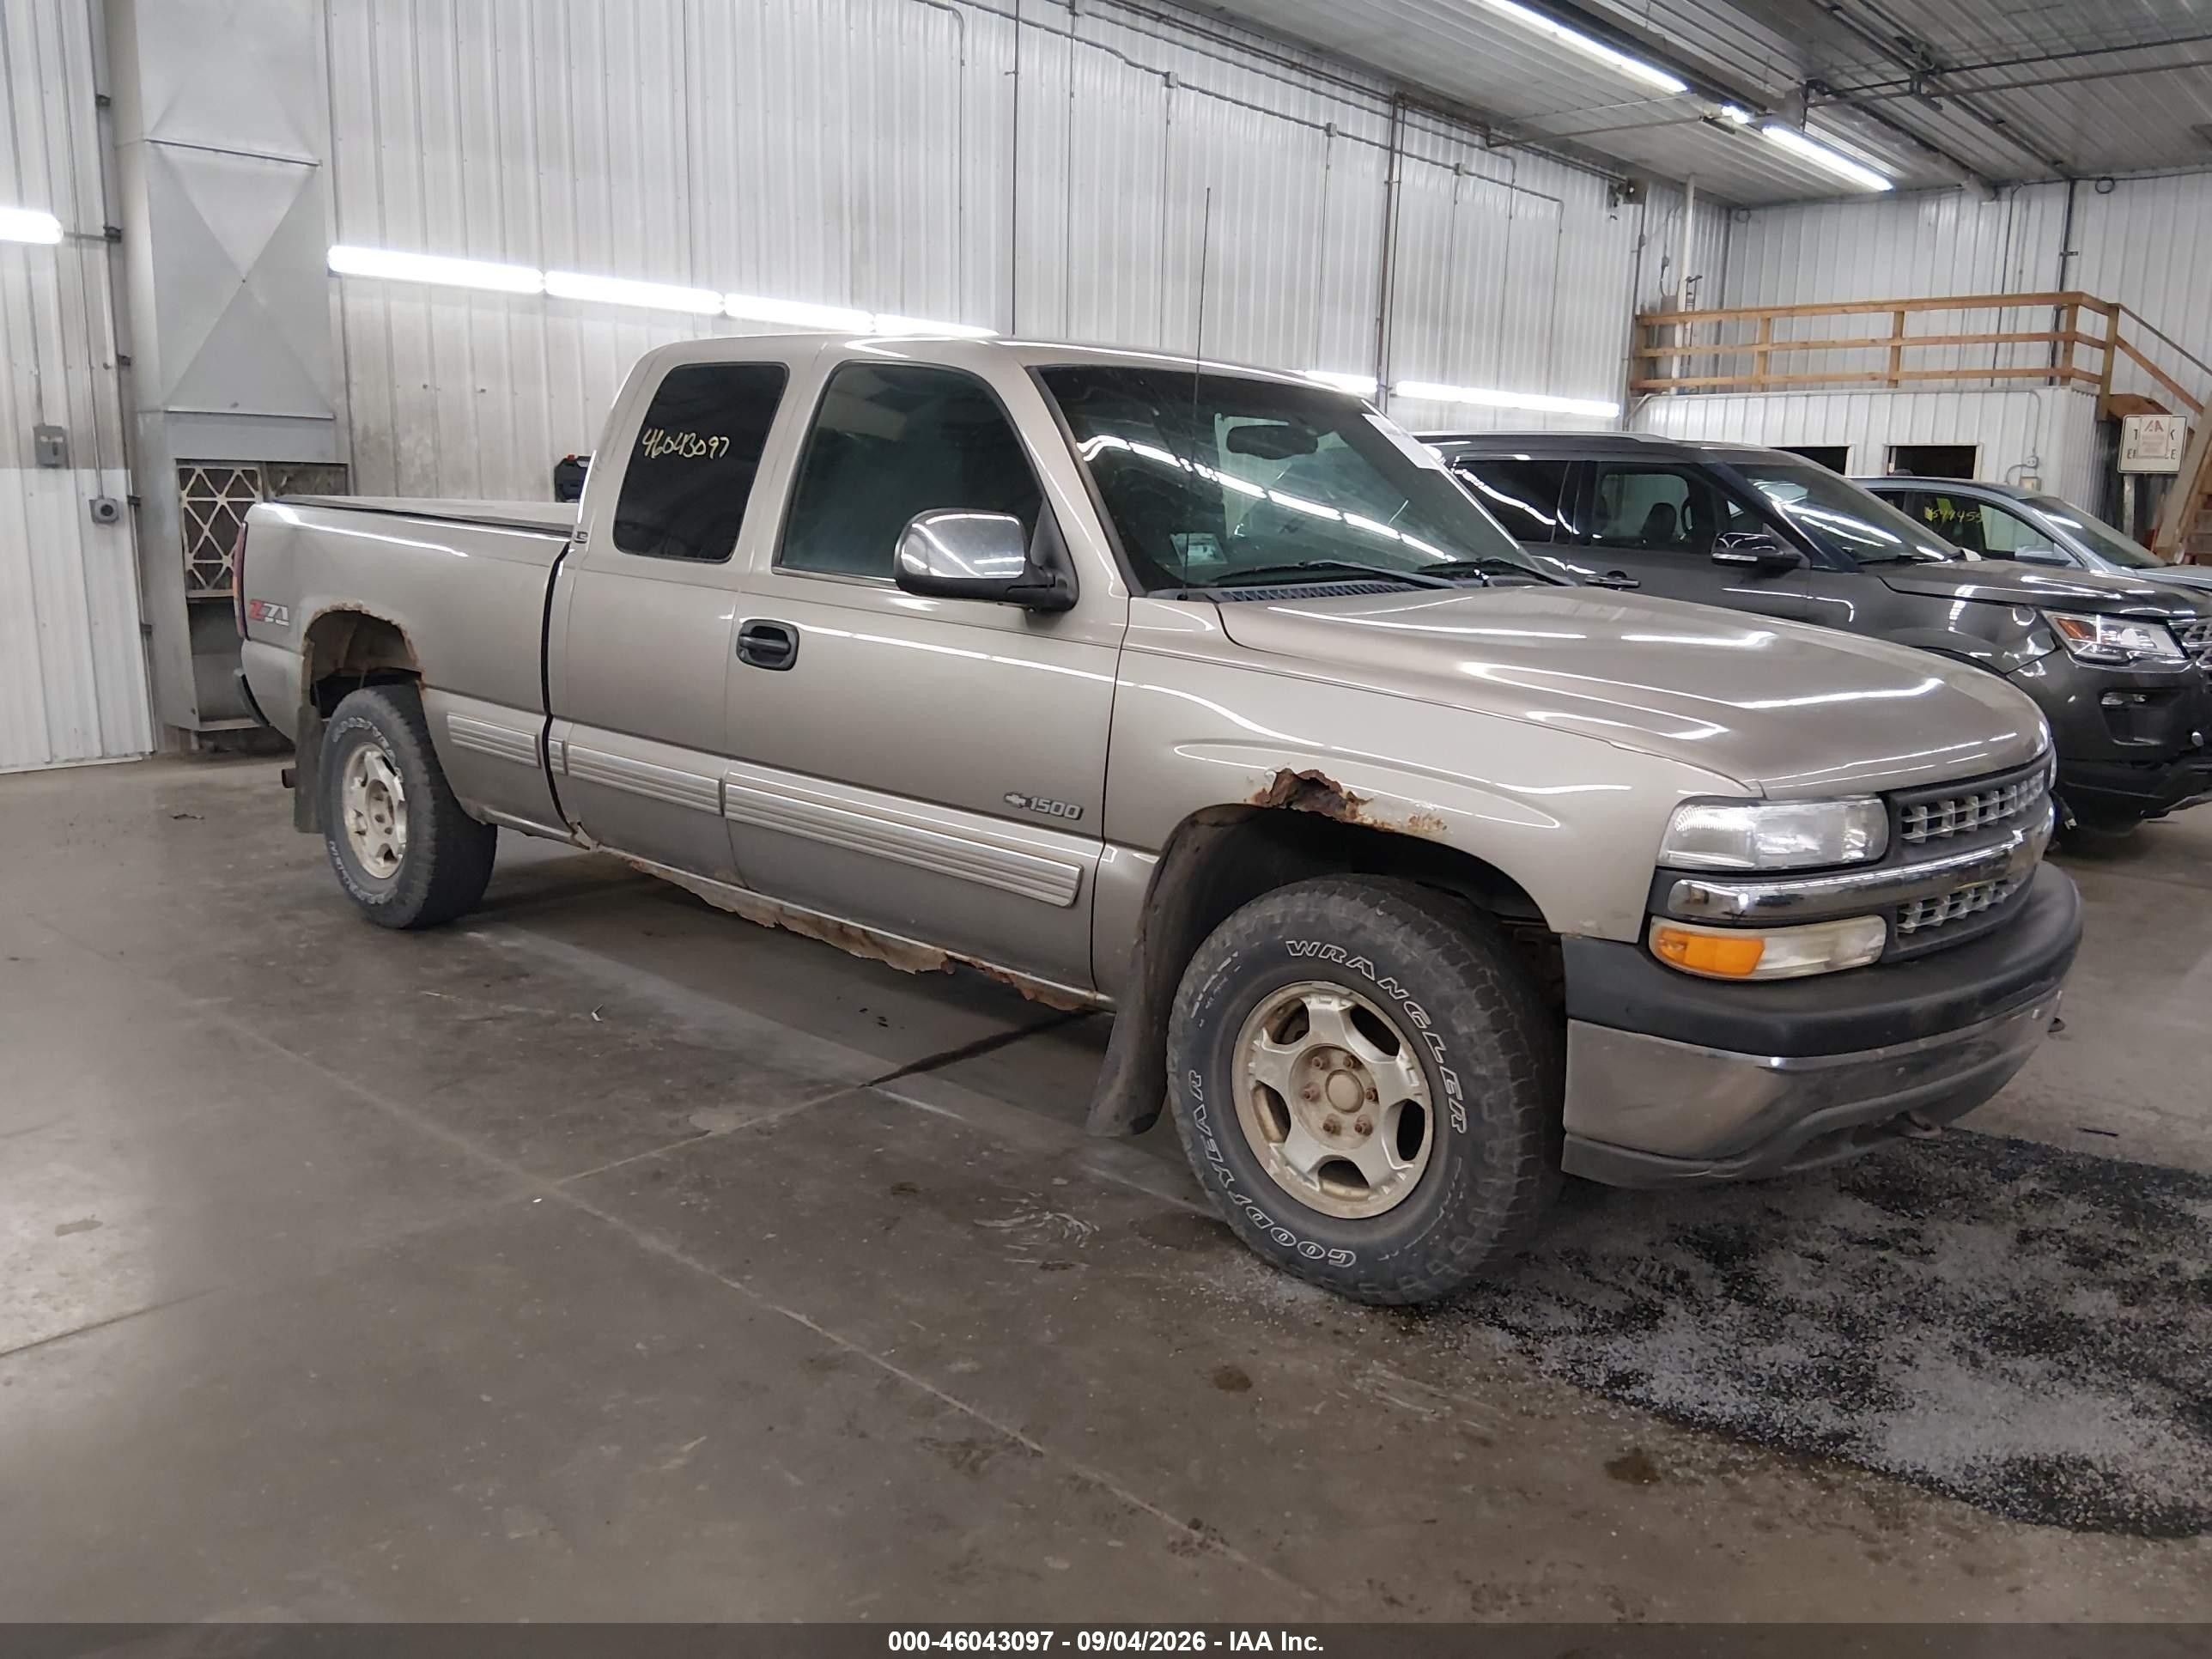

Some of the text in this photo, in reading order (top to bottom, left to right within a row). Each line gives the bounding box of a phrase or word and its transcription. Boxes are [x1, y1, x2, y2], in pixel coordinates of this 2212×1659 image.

[641, 428, 730, 459] 46043097
[247, 599, 289, 626] Z71
[1030, 796, 1082, 820] 1500
[1285, 940, 1468, 1134] WRANGLER
[1188, 1070, 1357, 1268] GOODYEAR
